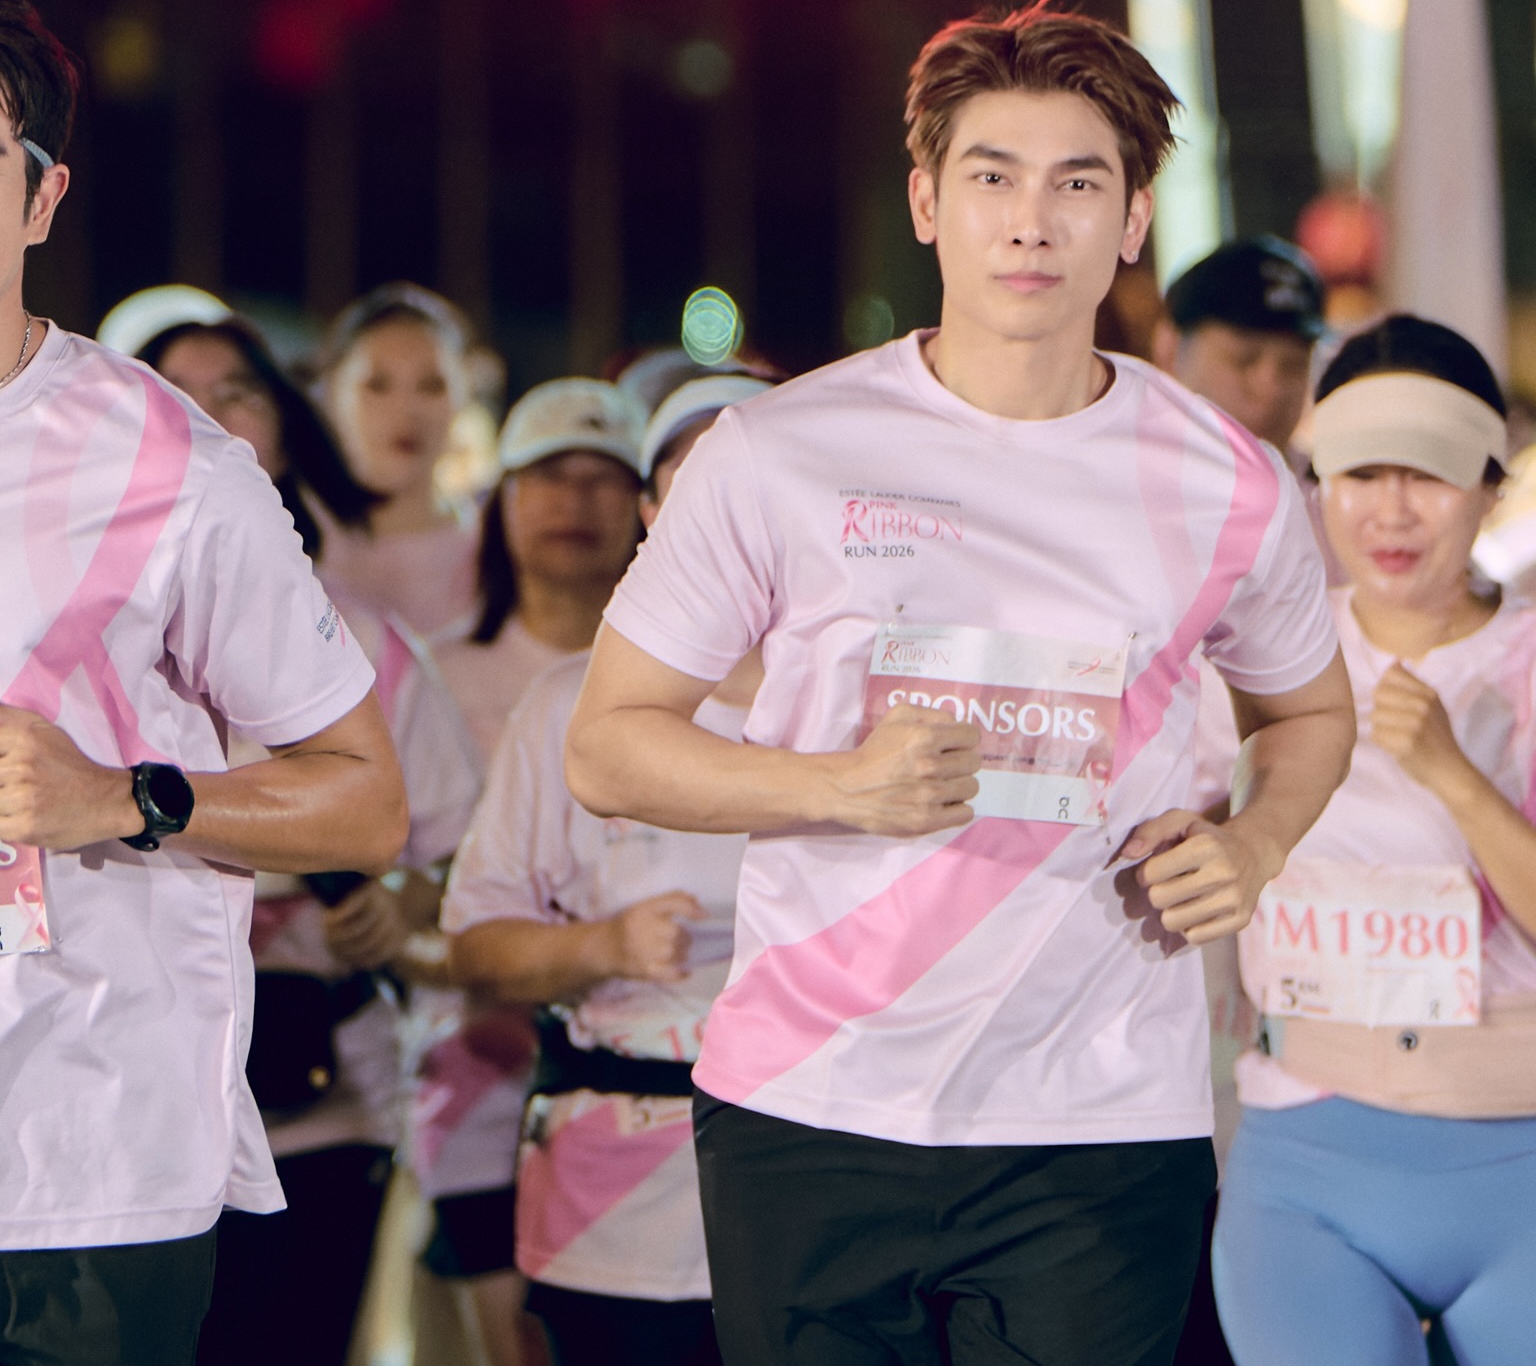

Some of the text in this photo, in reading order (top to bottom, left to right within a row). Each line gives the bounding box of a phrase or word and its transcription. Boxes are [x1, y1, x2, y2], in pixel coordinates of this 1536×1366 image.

[869, 500, 897, 510] PINK
[840, 499, 964, 544] RIBBON
[844, 545, 915, 558] RUN 2026
[1272, 900, 1470, 961] M1980
